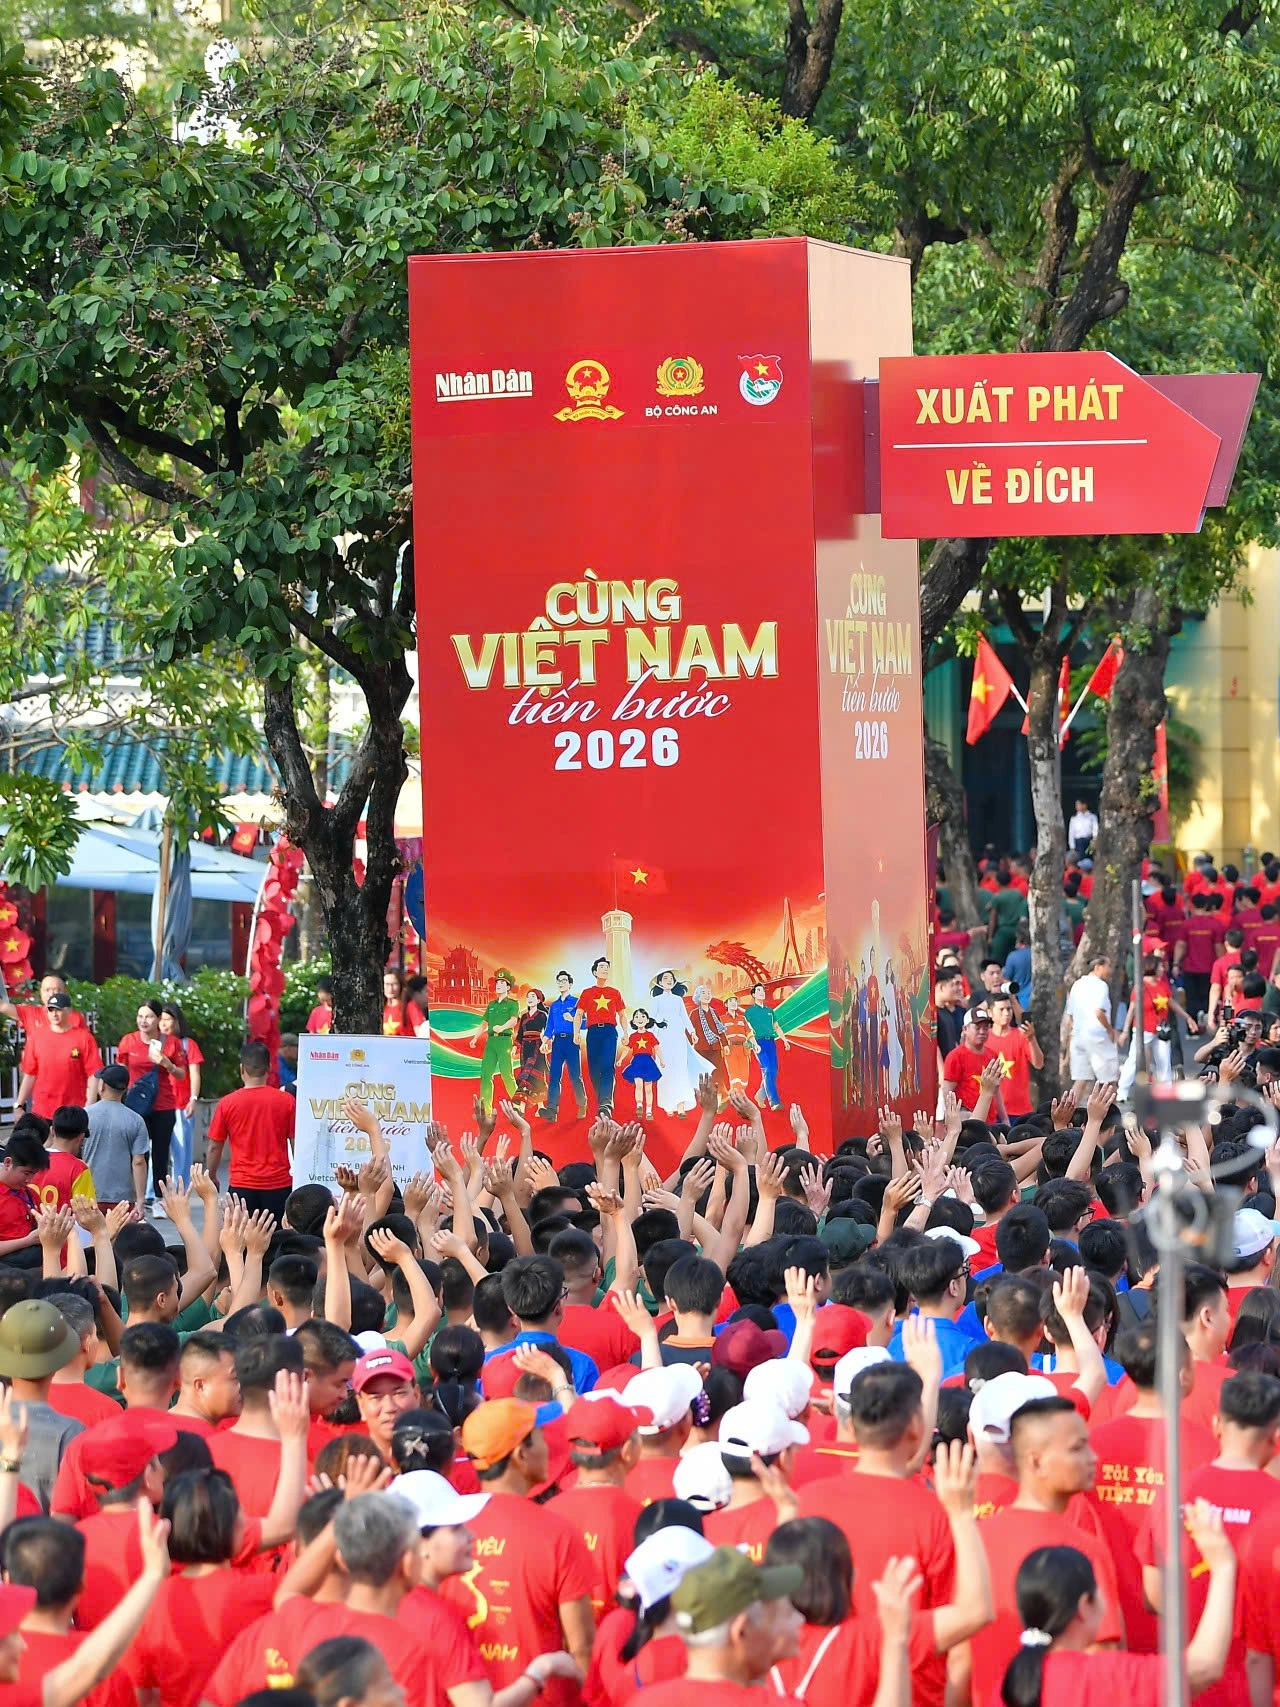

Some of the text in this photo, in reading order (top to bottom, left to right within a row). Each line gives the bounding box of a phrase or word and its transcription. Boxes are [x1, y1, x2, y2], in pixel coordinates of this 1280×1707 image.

[435, 369, 532, 395] Nhân Dân
[916, 378, 1123, 424] XUẤT PHÁT
[645, 404, 718, 418] BỘ CÔNG AN
[946, 460, 1094, 504] VỀ ĐÍCH
[546, 568, 681, 626] CÙNG
[850, 560, 886, 616] CÙNG
[450, 618, 779, 695] VIỆT NAM
[825, 606, 912, 684] VIỆT NAM
[508, 668, 732, 725] tiến bước
[841, 662, 901, 712] tiến bước
[555, 728, 679, 770] 2026
[854, 720, 888, 760] 2026
[345, 1079, 395, 1100] CÙNG
[374, 1100, 430, 1123] NAM
[1096, 1482, 1134, 1506] VIỆT
[1102, 1464, 1165, 1485] Tôi Yêu
[476, 1535, 506, 1556] YÊU
